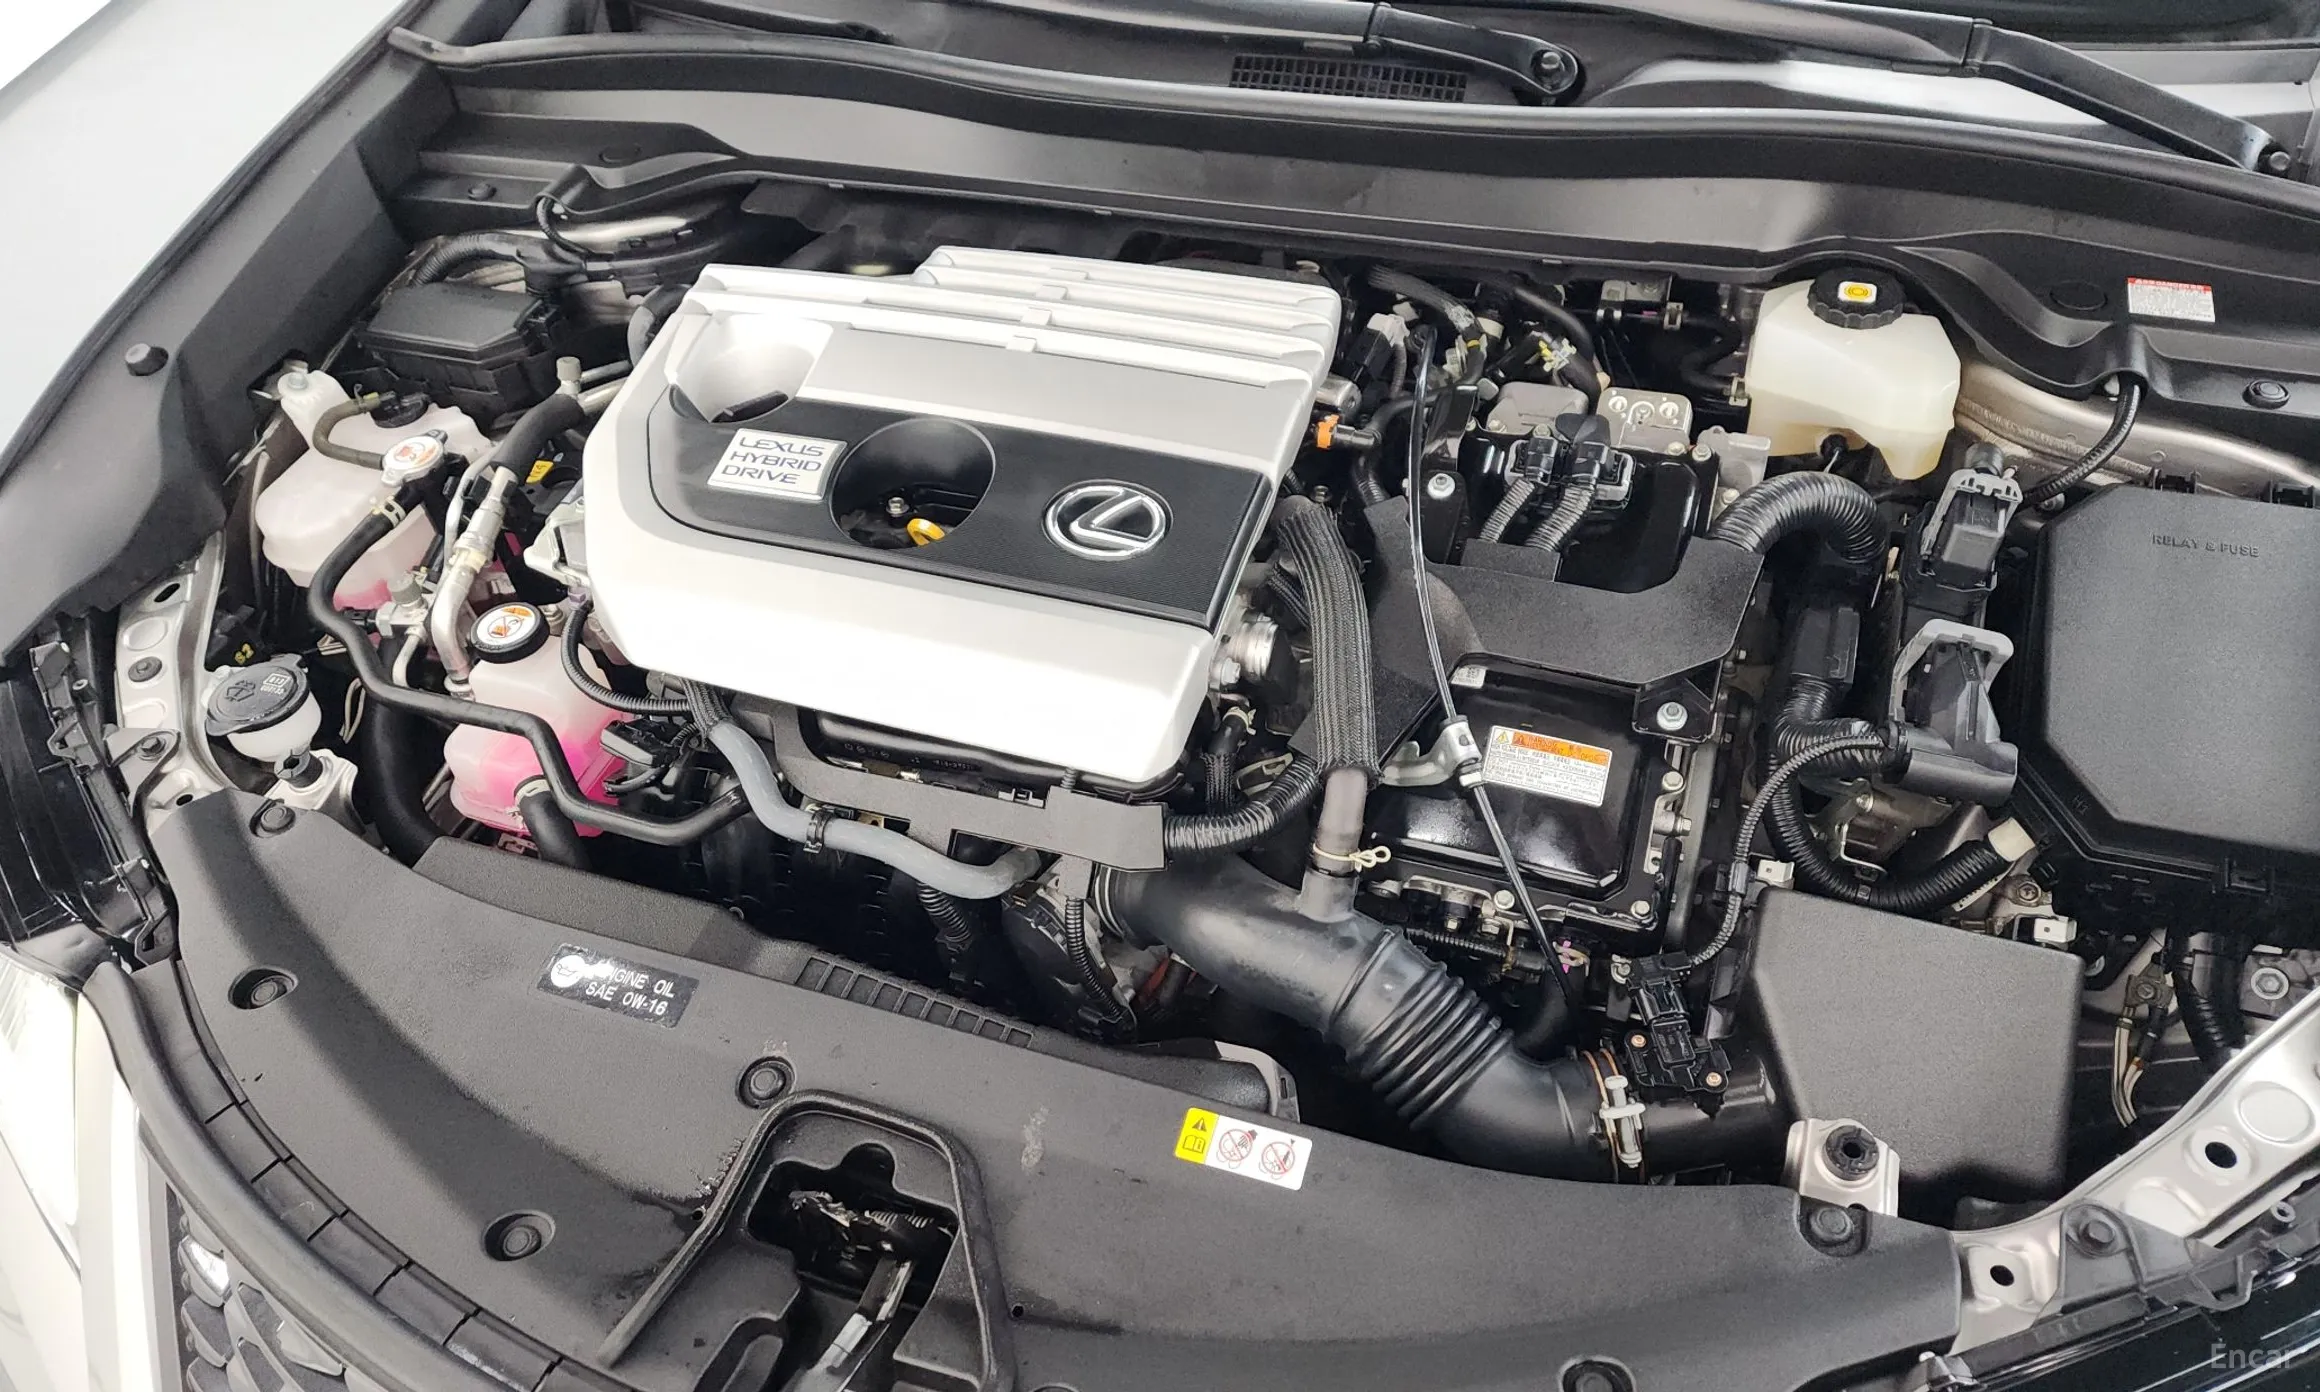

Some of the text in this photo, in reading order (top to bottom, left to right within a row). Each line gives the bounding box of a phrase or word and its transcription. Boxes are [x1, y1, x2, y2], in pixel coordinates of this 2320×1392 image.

[739, 436, 826, 456] LEXUS
[730, 450, 822, 472] HYBRID
[721, 464, 801, 484] DRIVE
[2151, 534, 2198, 549] RELAY
[2219, 543, 2260, 558] FUSE
[592, 961, 675, 998] GINE OIL
[585, 981, 618, 1001] SAE
